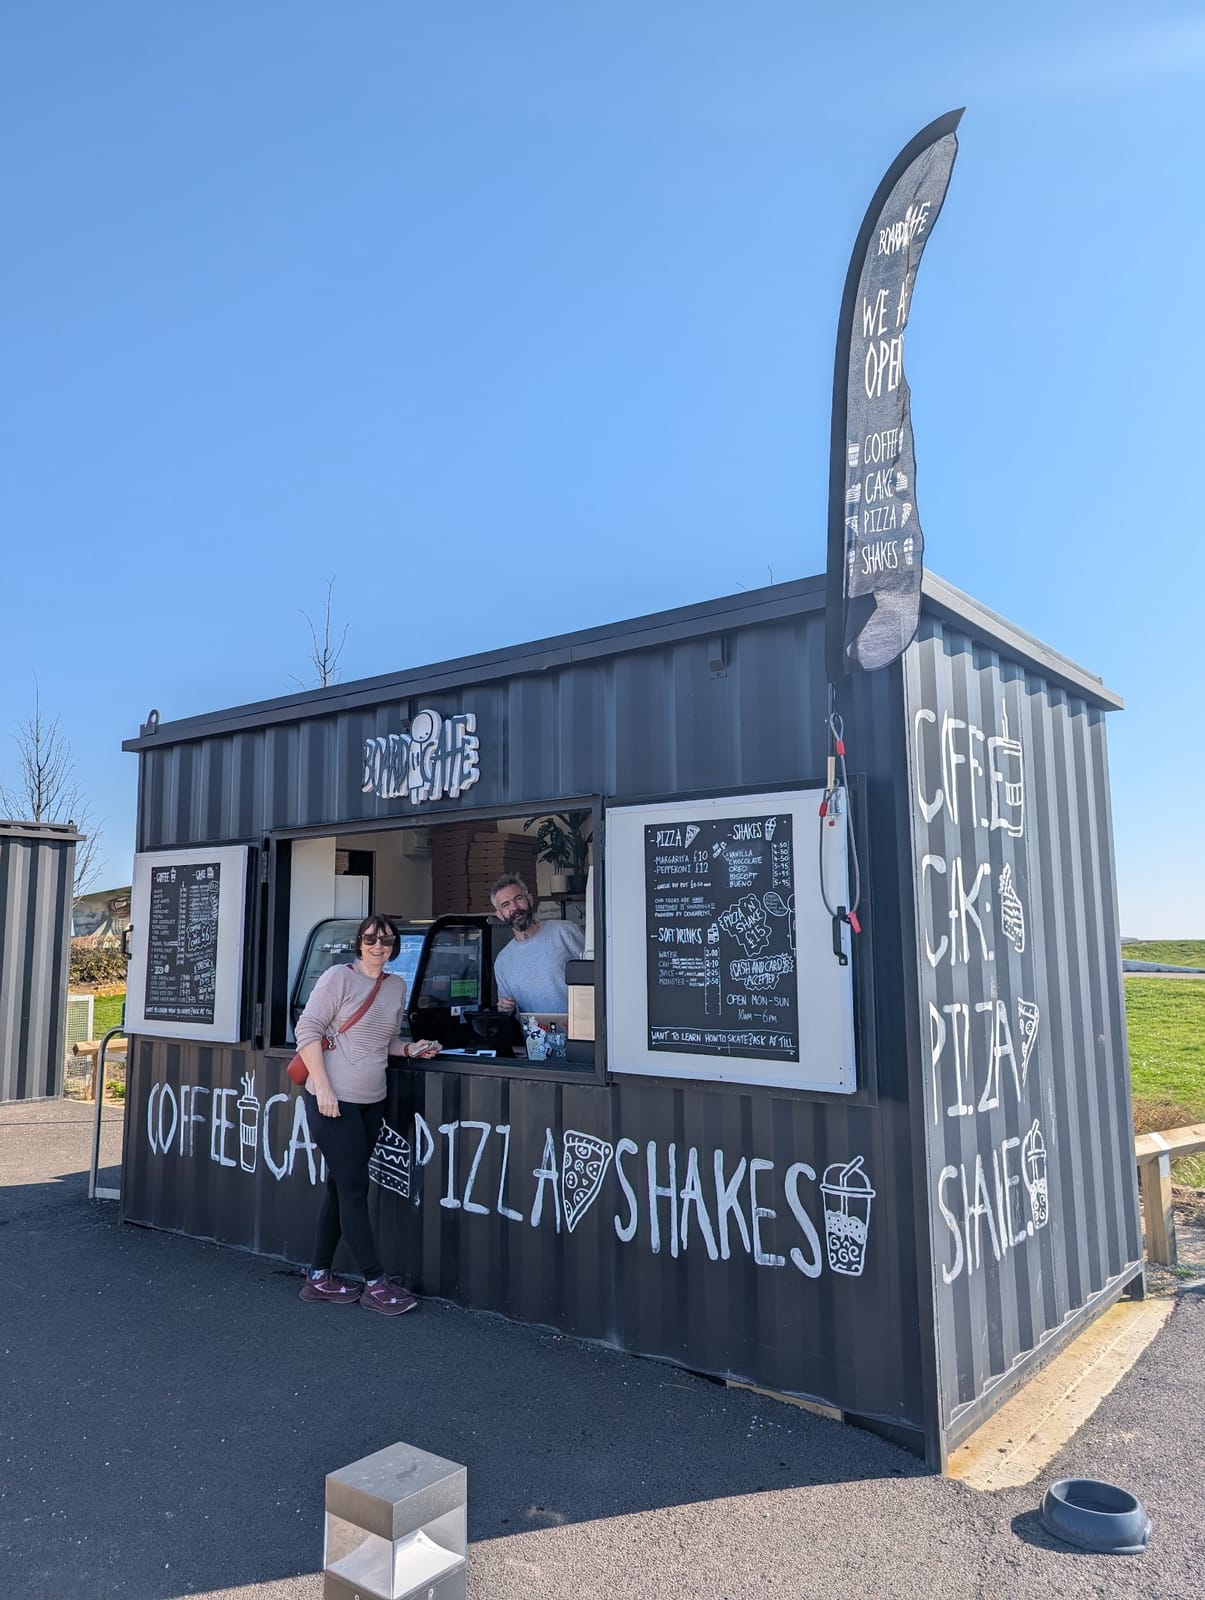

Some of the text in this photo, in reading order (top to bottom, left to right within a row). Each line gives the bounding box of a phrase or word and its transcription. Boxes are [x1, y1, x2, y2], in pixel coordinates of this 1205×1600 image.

[863, 289, 889, 337] WE
[865, 467, 894, 504] CAKE
[864, 504, 896, 533] PIZZA
[861, 540, 898, 574] SHAKES
[656, 829, 682, 848] PIZZA
[733, 822, 762, 841] SHAKES
[693, 850, 708, 863] £10
[729, 850, 753, 858] VANILLA
[729, 856, 762, 865] CHOCOLATE
[656, 863, 709, 874] PEPPERONI £12
[730, 872, 759, 880] BISCOFF
[730, 880, 752, 888] BUENO
[723, 907, 745, 928] PIZZA
[736, 908, 763, 933] SHAKE
[658, 928, 702, 944] SOFT DRINKS
[745, 925, 765, 949] £15
[732, 961, 750, 977] CASH
[752, 961, 764, 974] AND
[727, 993, 746, 1006] OPEN
[651, 1031, 669, 1040] WANT
[671, 1032, 680, 1040] TO
[681, 1033, 701, 1042] LEARN
[769, 1037, 777, 1046] AT
[147, 1082, 241, 1168] COFFEE
[263, 1093, 326, 1186] CA
[414, 1112, 562, 1235] PIZZA
[614, 1137, 823, 1279] SHAKES
